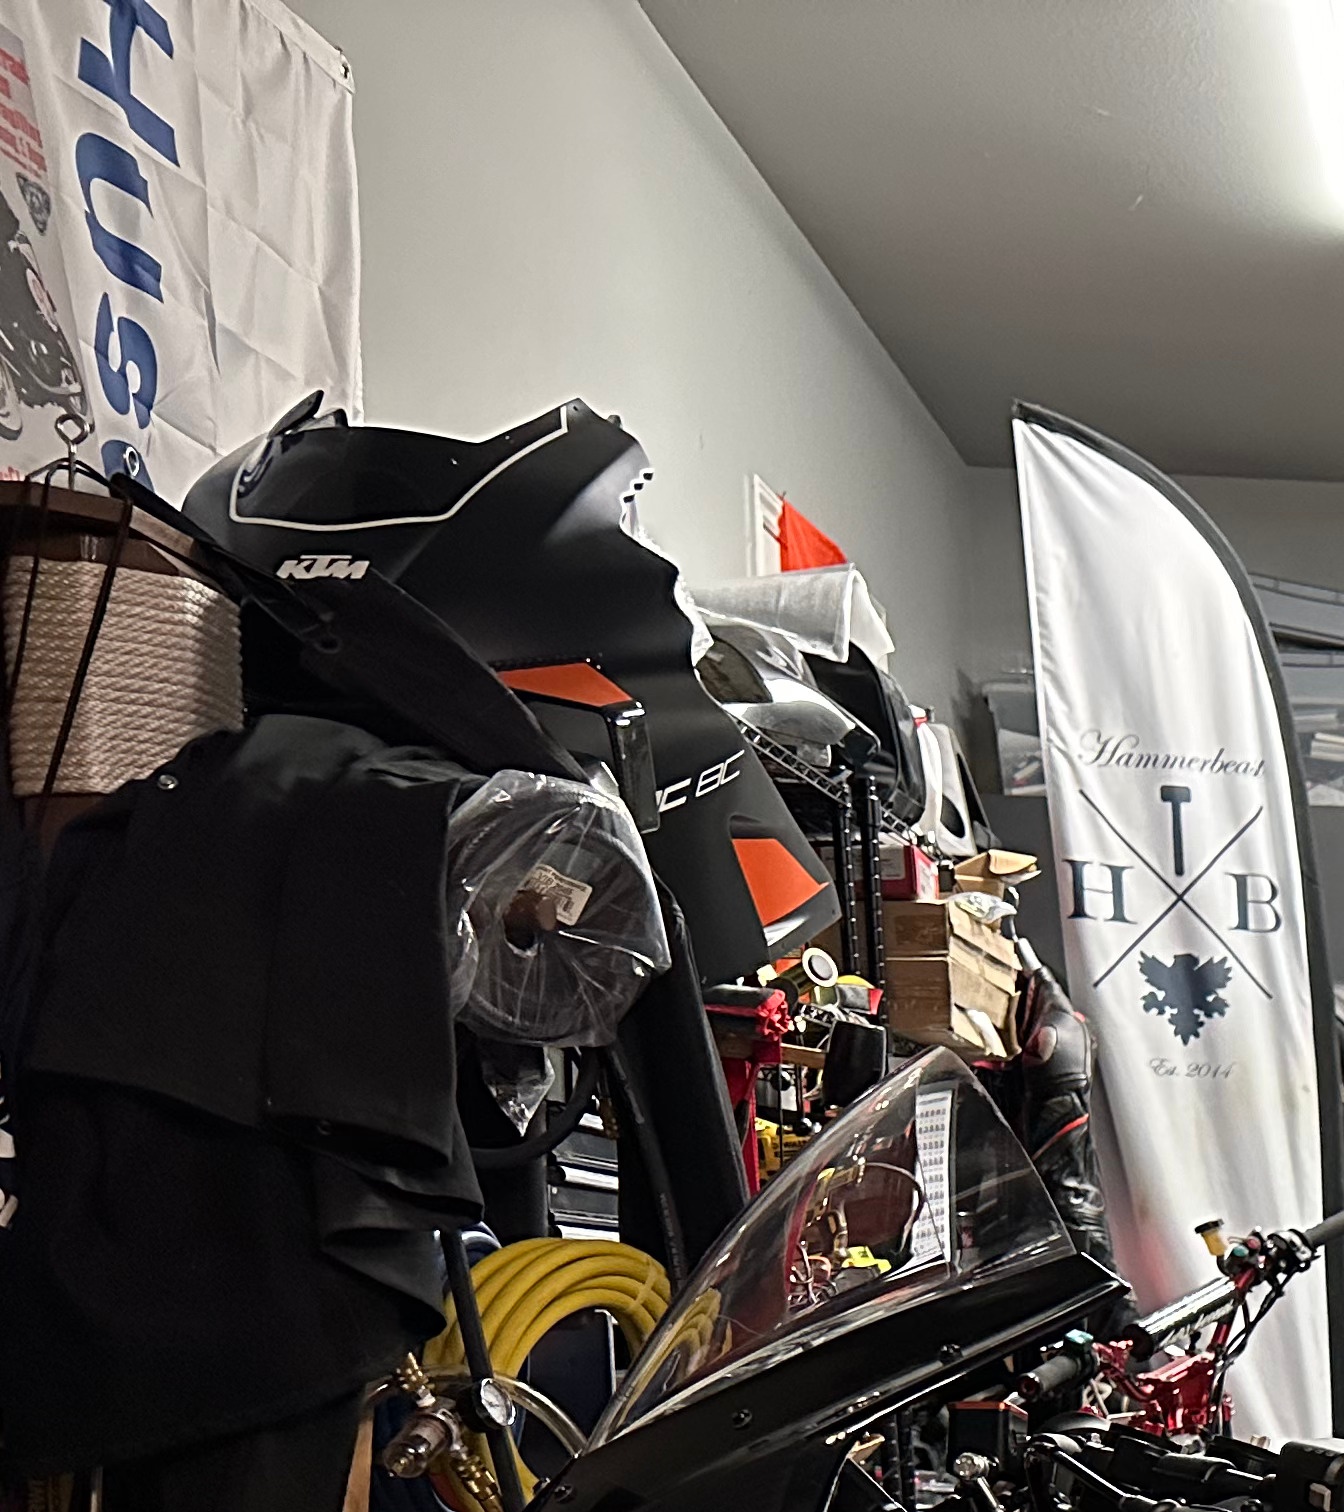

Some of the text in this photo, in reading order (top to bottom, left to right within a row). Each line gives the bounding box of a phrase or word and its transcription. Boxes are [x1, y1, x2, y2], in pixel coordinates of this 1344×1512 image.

[276, 554, 370, 579] KTM
[1061, 858, 1282, 933] H B
[1184, 1062, 1236, 1079] 2014
